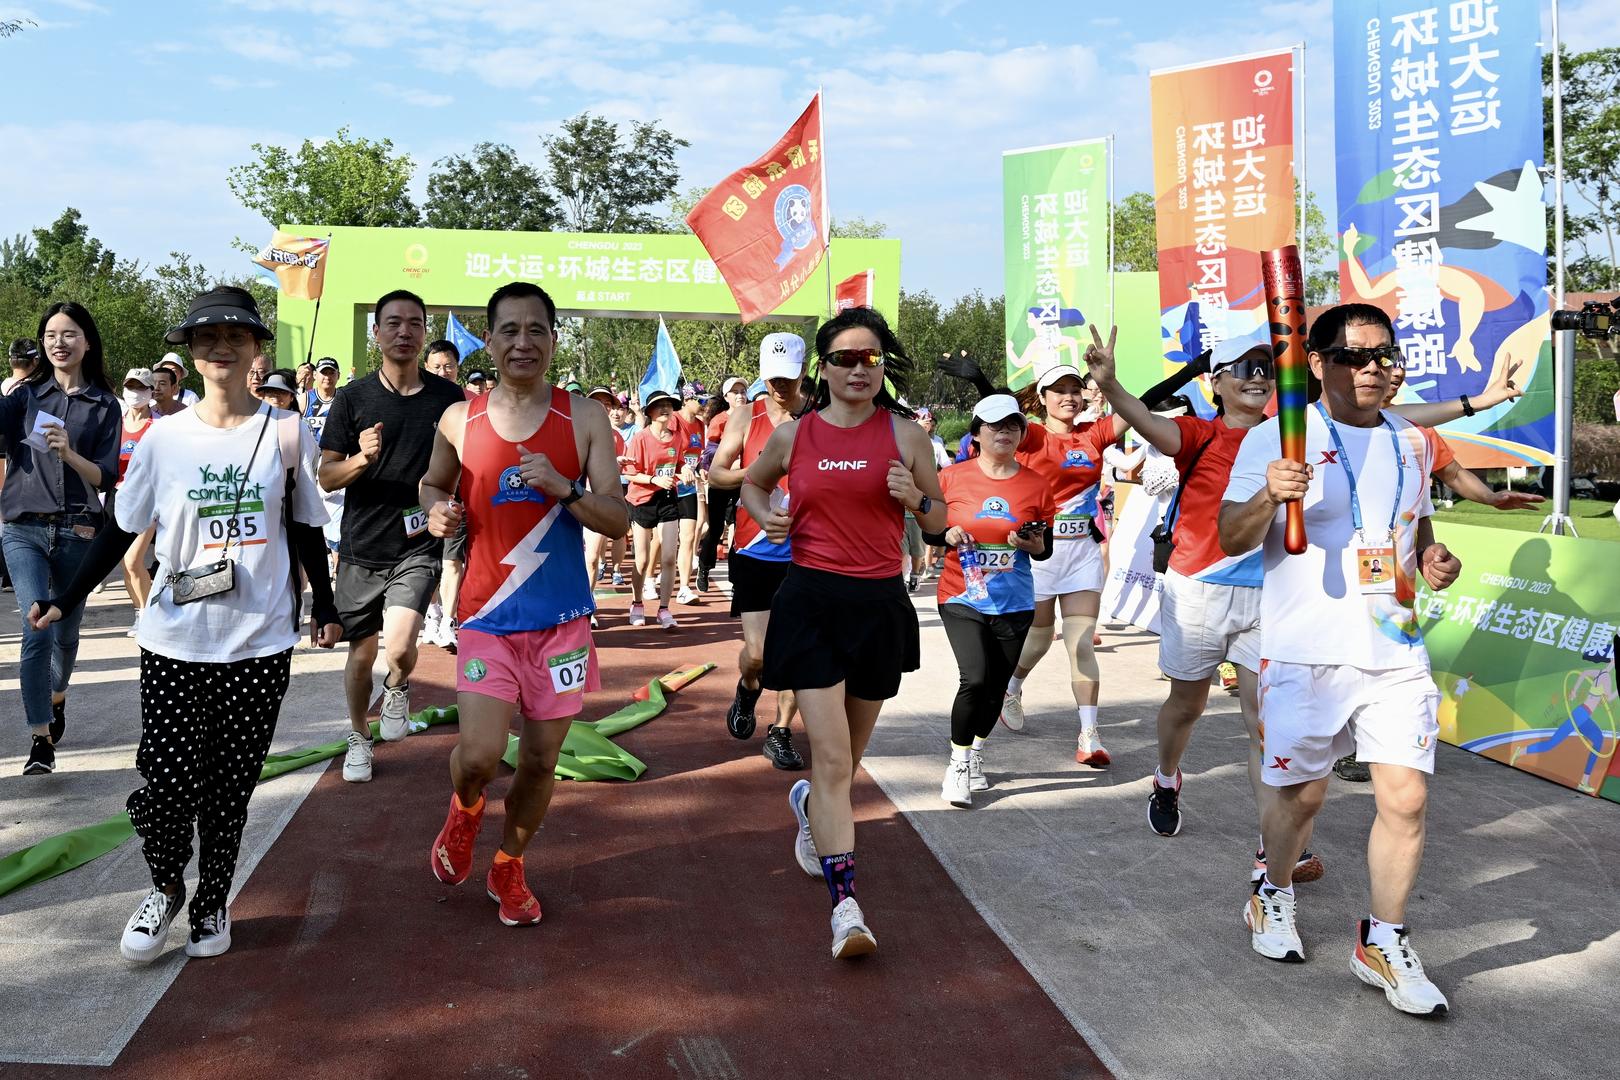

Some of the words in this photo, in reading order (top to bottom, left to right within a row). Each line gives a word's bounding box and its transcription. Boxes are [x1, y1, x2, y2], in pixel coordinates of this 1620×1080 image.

[568, 241, 619, 251] CHENGDU
[465, 252, 722, 284] 迎大运·环城生态区健
[210, 516, 257, 539] 085
[1059, 522, 1086, 534] 055
[1480, 572, 1529, 590] CHENGDU
[1528, 581, 1552, 595] 2023
[1414, 586, 1620, 659] 大运·环城生态区健康
